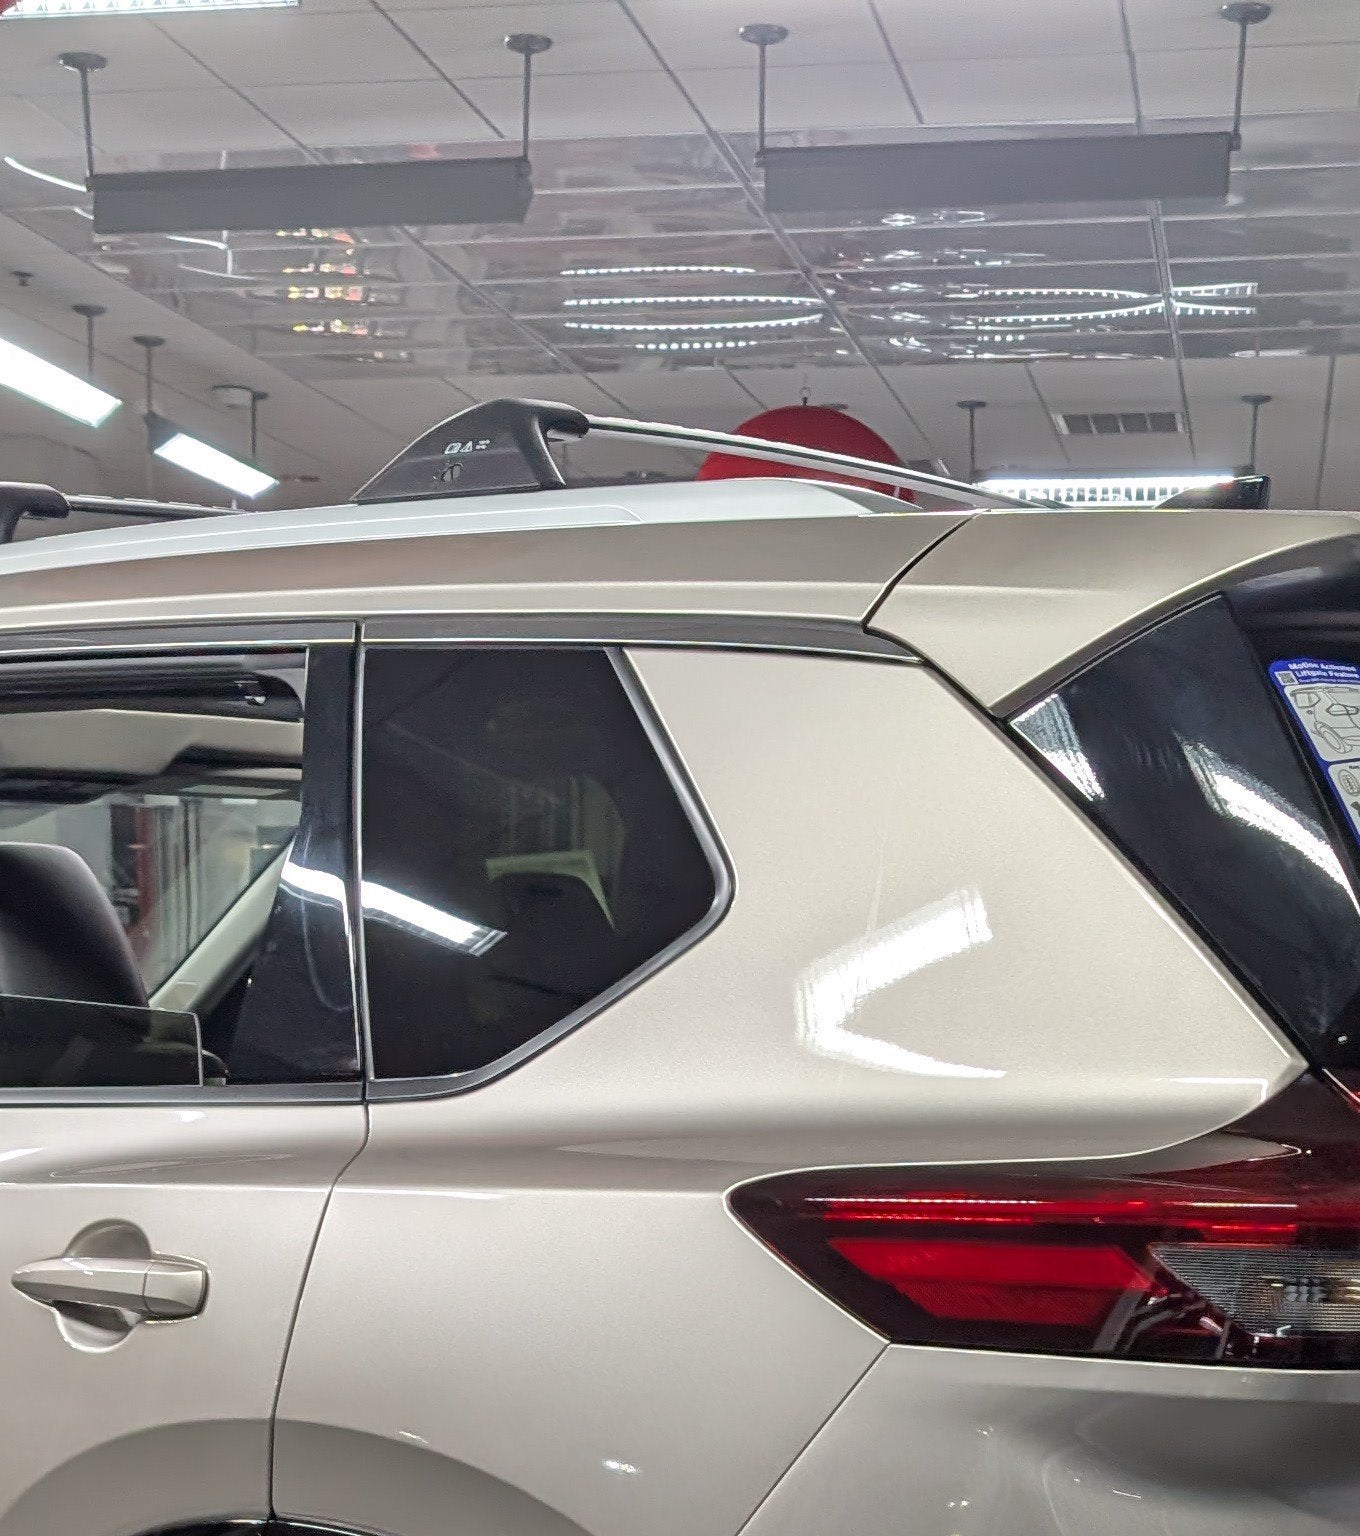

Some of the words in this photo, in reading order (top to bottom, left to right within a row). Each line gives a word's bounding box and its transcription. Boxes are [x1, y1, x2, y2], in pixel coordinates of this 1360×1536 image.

[1288, 661, 1319, 670] Motion
[1320, 662, 1357, 672] Activated
[1328, 670, 1360, 679] Feature
